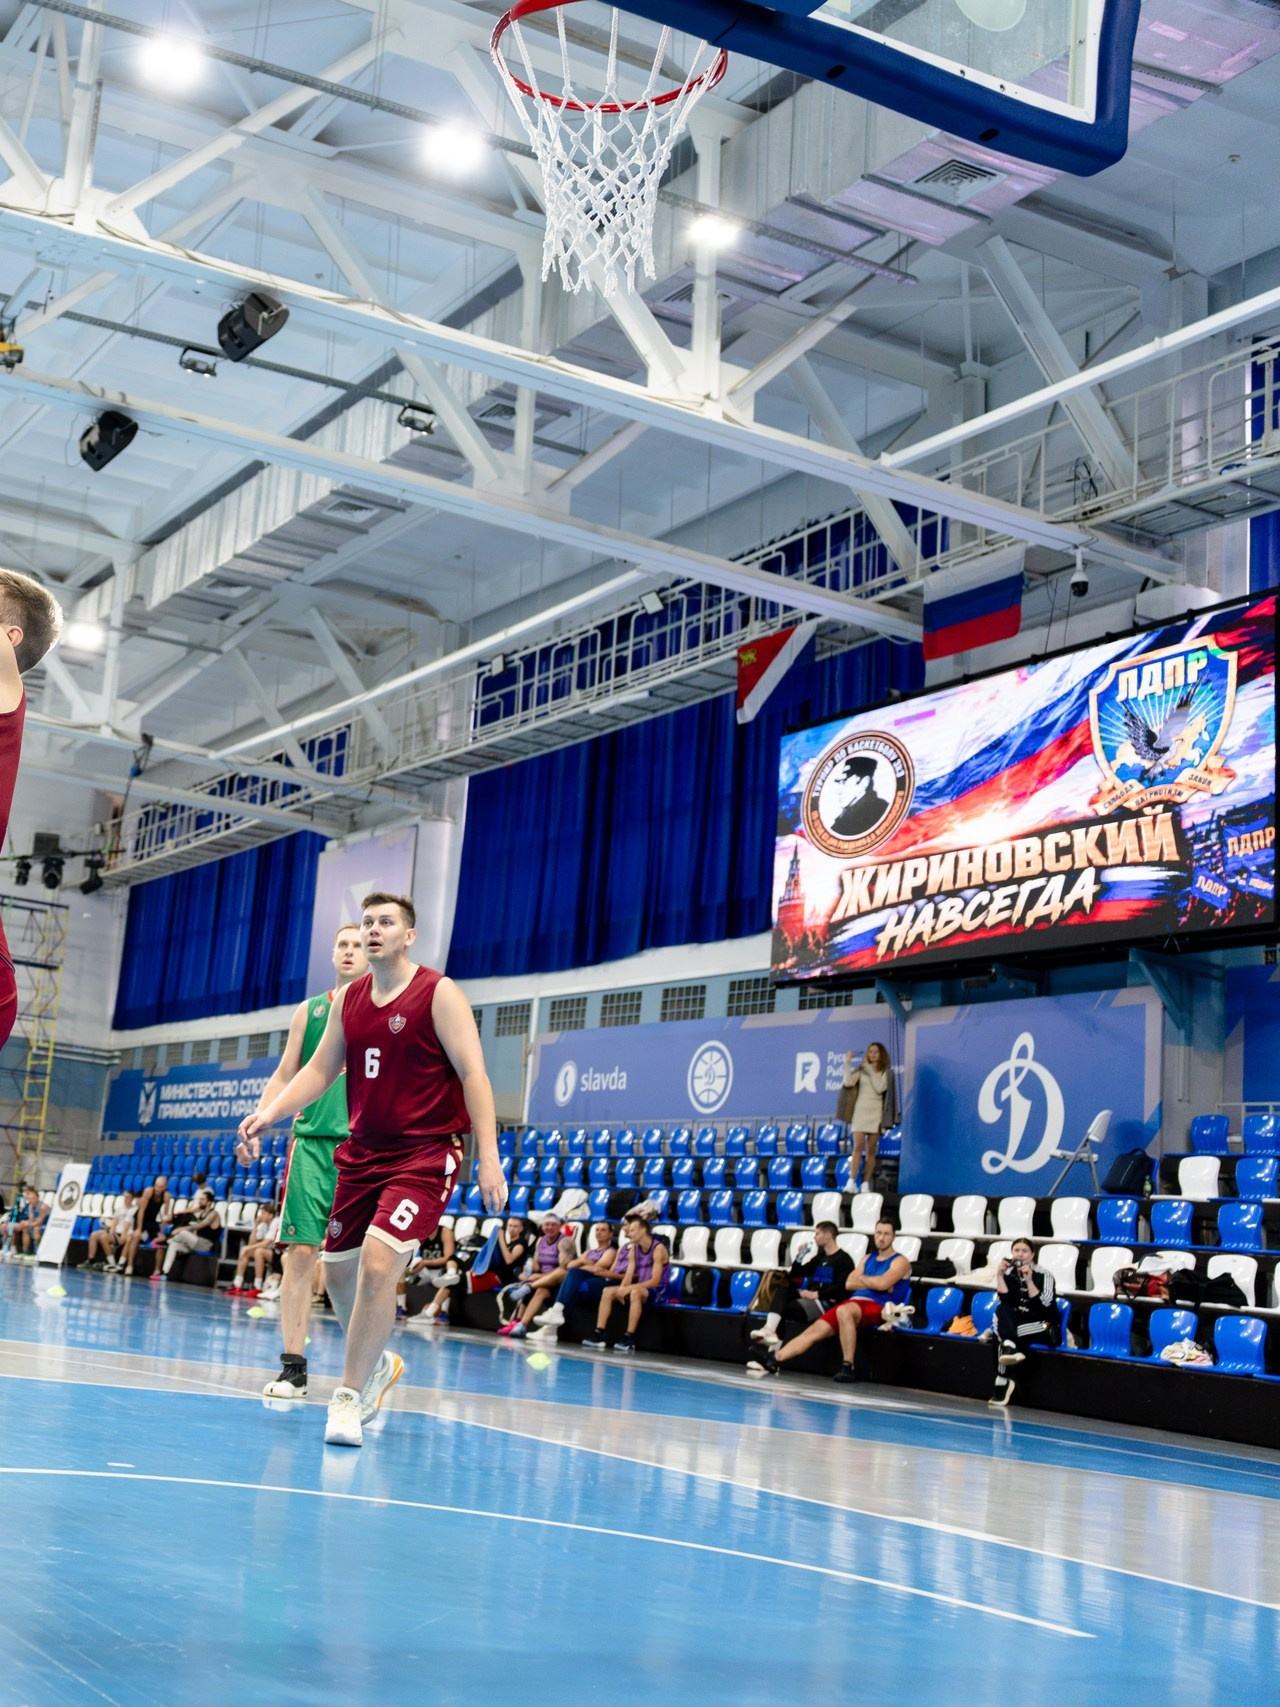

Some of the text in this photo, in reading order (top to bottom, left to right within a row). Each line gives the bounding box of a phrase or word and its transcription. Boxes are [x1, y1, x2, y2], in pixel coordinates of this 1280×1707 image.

[1116, 650, 1208, 703] ЛДПР
[1227, 826, 1275, 857] ЛДПР
[830, 805, 1180, 923] ЖИРИНОВСКИЙ
[1195, 875, 1228, 897] ЛДПР
[875, 867, 1101, 962] НАВСЕГДА
[365, 1048, 381, 1078] 6
[580, 1065, 627, 1091] slavda
[160, 1077, 271, 1101] МИНИСТЕРСТВО СПОР
[157, 1100, 230, 1119] ПРИМОРСКОГО
[389, 1198, 419, 1231] 6
